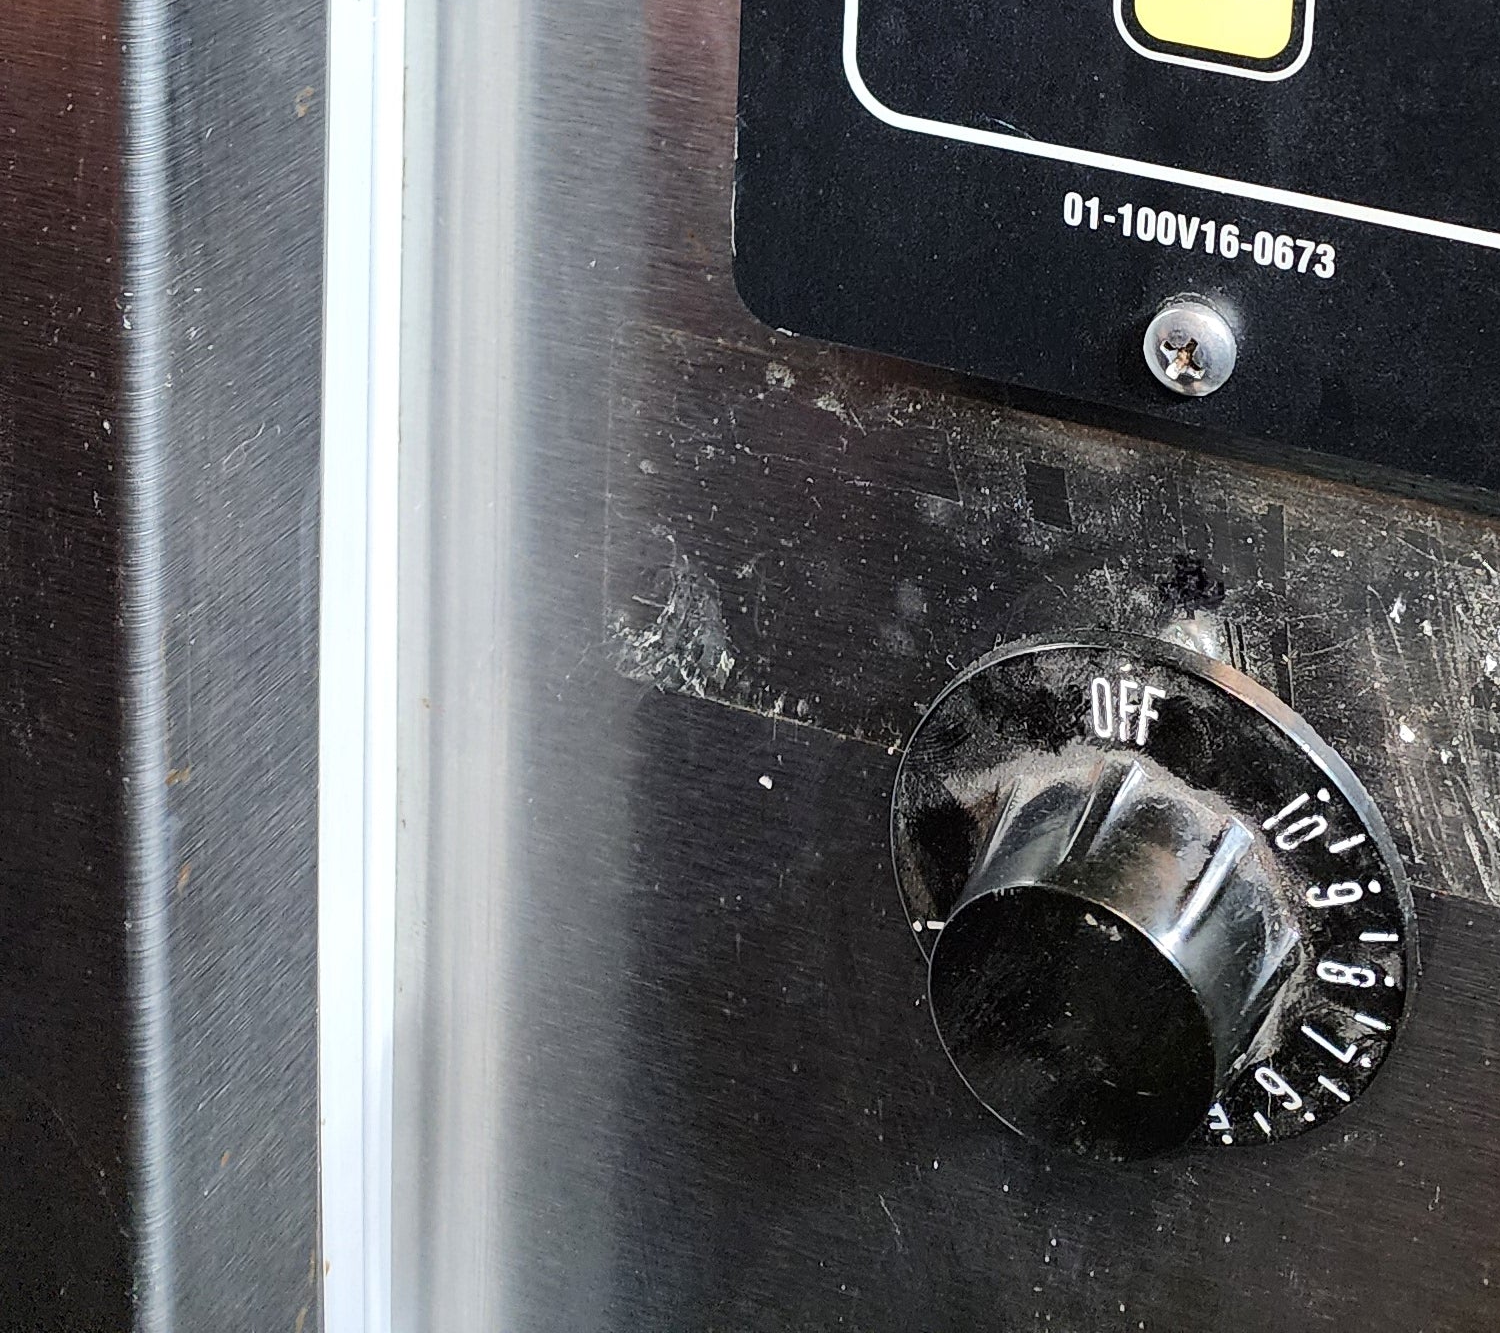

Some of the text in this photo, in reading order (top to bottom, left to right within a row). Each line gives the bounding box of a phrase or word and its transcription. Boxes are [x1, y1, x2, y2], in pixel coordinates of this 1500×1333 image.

[1063, 191, 1336, 279] 01-100V16-0673
[1090, 675, 1167, 746] OFF
[1262, 791, 1329, 852] 10
[1304, 880, 1364, 909] 9
[1315, 959, 1376, 988] 8
[1301, 1024, 1358, 1064] 7
[1254, 1066, 1303, 1111] 6
